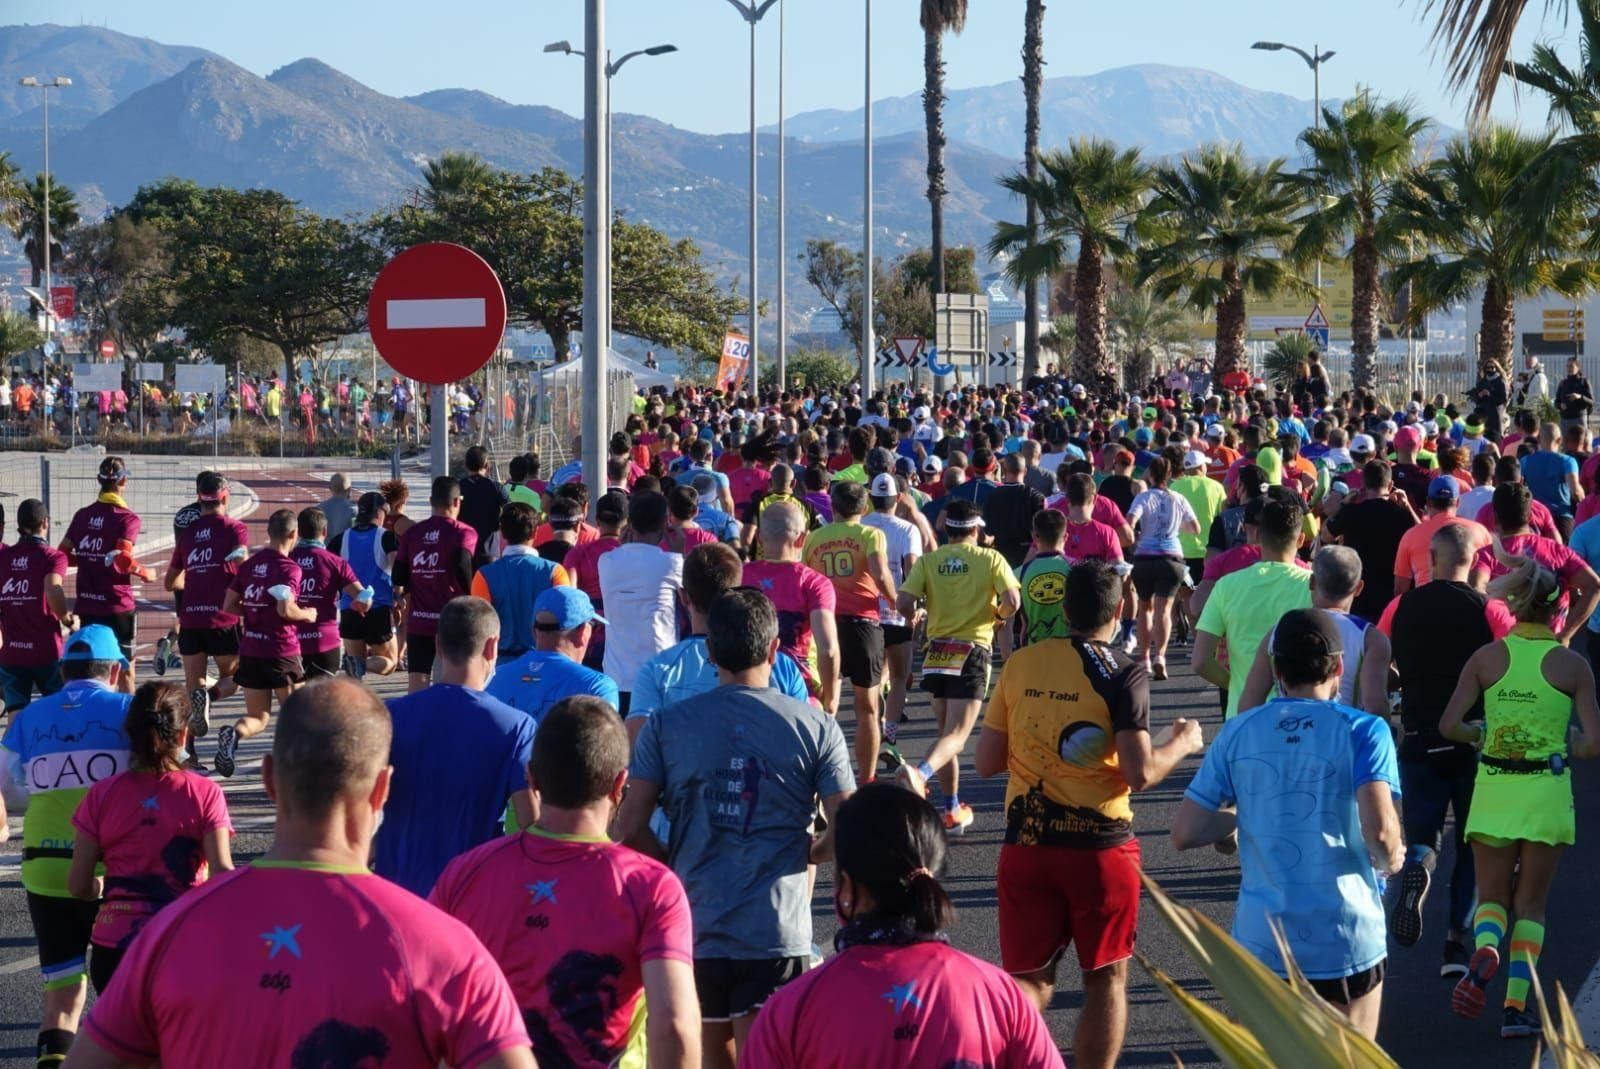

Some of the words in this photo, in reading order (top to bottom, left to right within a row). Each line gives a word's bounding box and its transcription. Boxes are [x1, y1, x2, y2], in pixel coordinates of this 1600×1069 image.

[731, 341, 750, 358] 20
[812, 537, 860, 556] ESPAÑA
[820, 550, 854, 578] 10
[937, 563, 969, 574] UTMB
[730, 758, 744, 770] ES
[727, 781, 742, 793] DE
